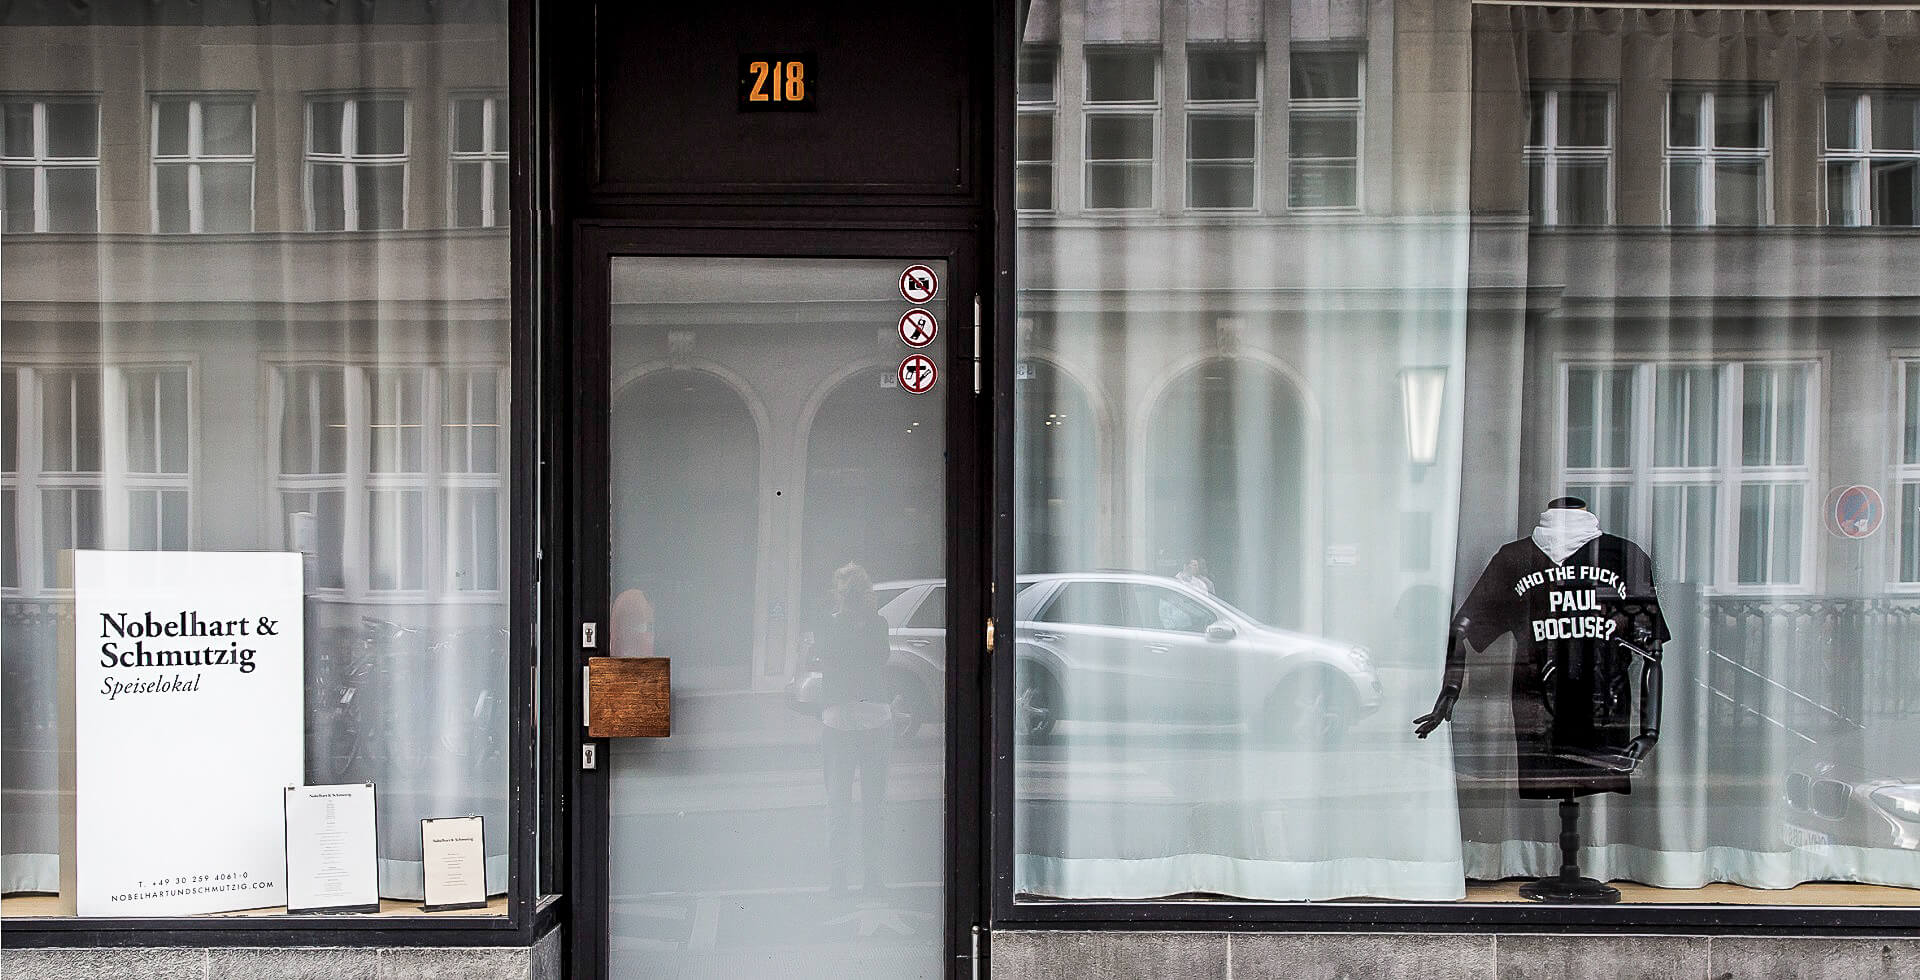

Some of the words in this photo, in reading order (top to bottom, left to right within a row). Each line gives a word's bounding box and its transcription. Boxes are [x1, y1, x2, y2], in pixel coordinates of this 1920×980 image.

[749, 61, 804, 101] 218
[1514, 571, 1545, 597] WHO
[1545, 565, 1576, 582] THE
[1580, 566, 1619, 588] FUCK
[1617, 581, 1627, 600] IS
[1549, 589, 1602, 612] PAUL
[100, 611, 250, 638] Nobelhart
[256, 616, 279, 636] &
[1532, 616, 1617, 641] BOCUSE?
[100, 641, 256, 673] Schmutzig
[100, 674, 201, 700] Speiselokal
[111, 881, 274, 902] NOBELHARTUNDSCHMUTZIG.COM
[152, 878, 170, 886] +49
[175, 877, 187, 885] 30
[192, 875, 209, 883] 259
